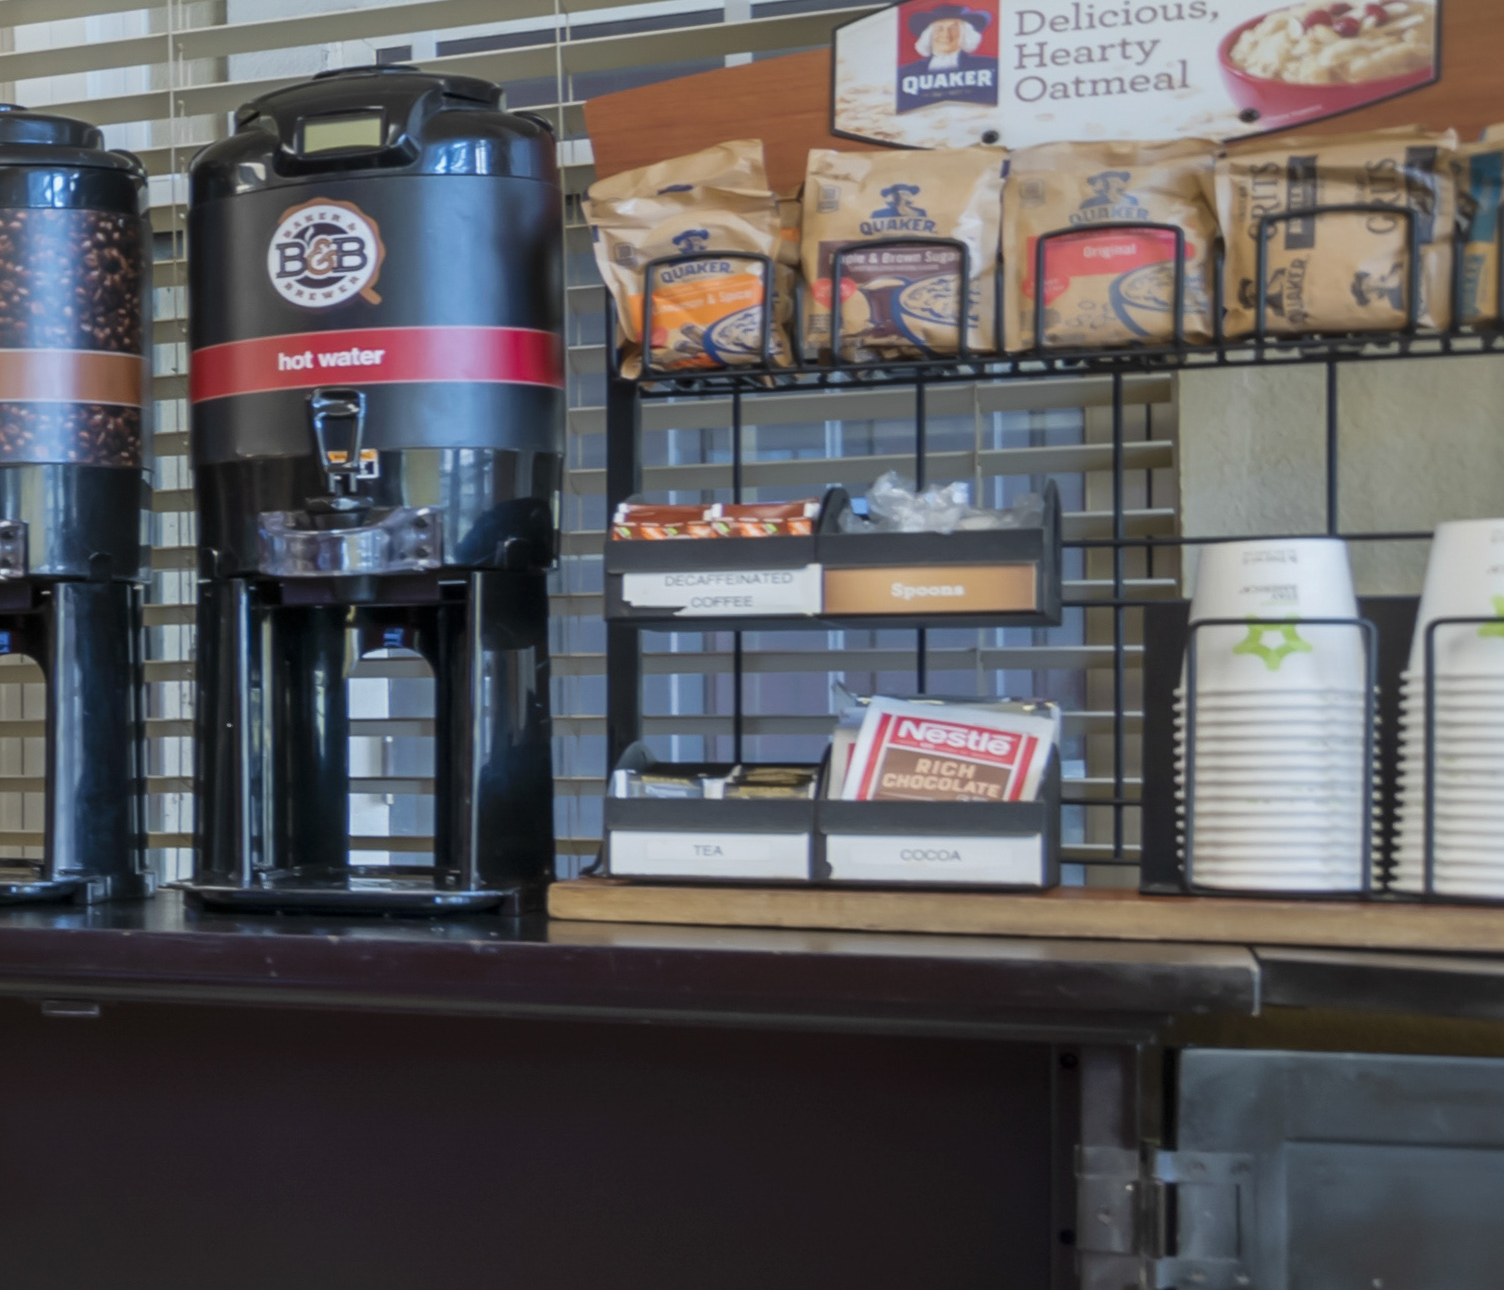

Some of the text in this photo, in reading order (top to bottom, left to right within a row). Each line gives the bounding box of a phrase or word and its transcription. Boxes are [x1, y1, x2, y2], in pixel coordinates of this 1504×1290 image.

[1014, 0, 1220, 36] Delicious,
[1014, 38, 1162, 69] Hearty
[902, 70, 994, 94] QUAKER
[1014, 61, 1190, 103] Oatmeal
[282, 213, 341, 238] BAKER
[860, 218, 937, 236] QUAKER
[275, 236, 368, 279] B&B
[882, 252, 922, 264] Brown
[1083, 243, 1137, 259] Original
[661, 261, 734, 284] QUAKER
[284, 276, 360, 301] BREWER
[278, 347, 385, 371] hot water
[664, 572, 793, 588] DECAFFEINATED
[891, 581, 966, 600] Spoons
[690, 596, 753, 609] COFFEE
[915, 759, 976, 780] RICH
[882, 773, 1001, 798] CHOCOLATE
[693, 843, 724, 857] TEA
[900, 849, 962, 862] COCOA
